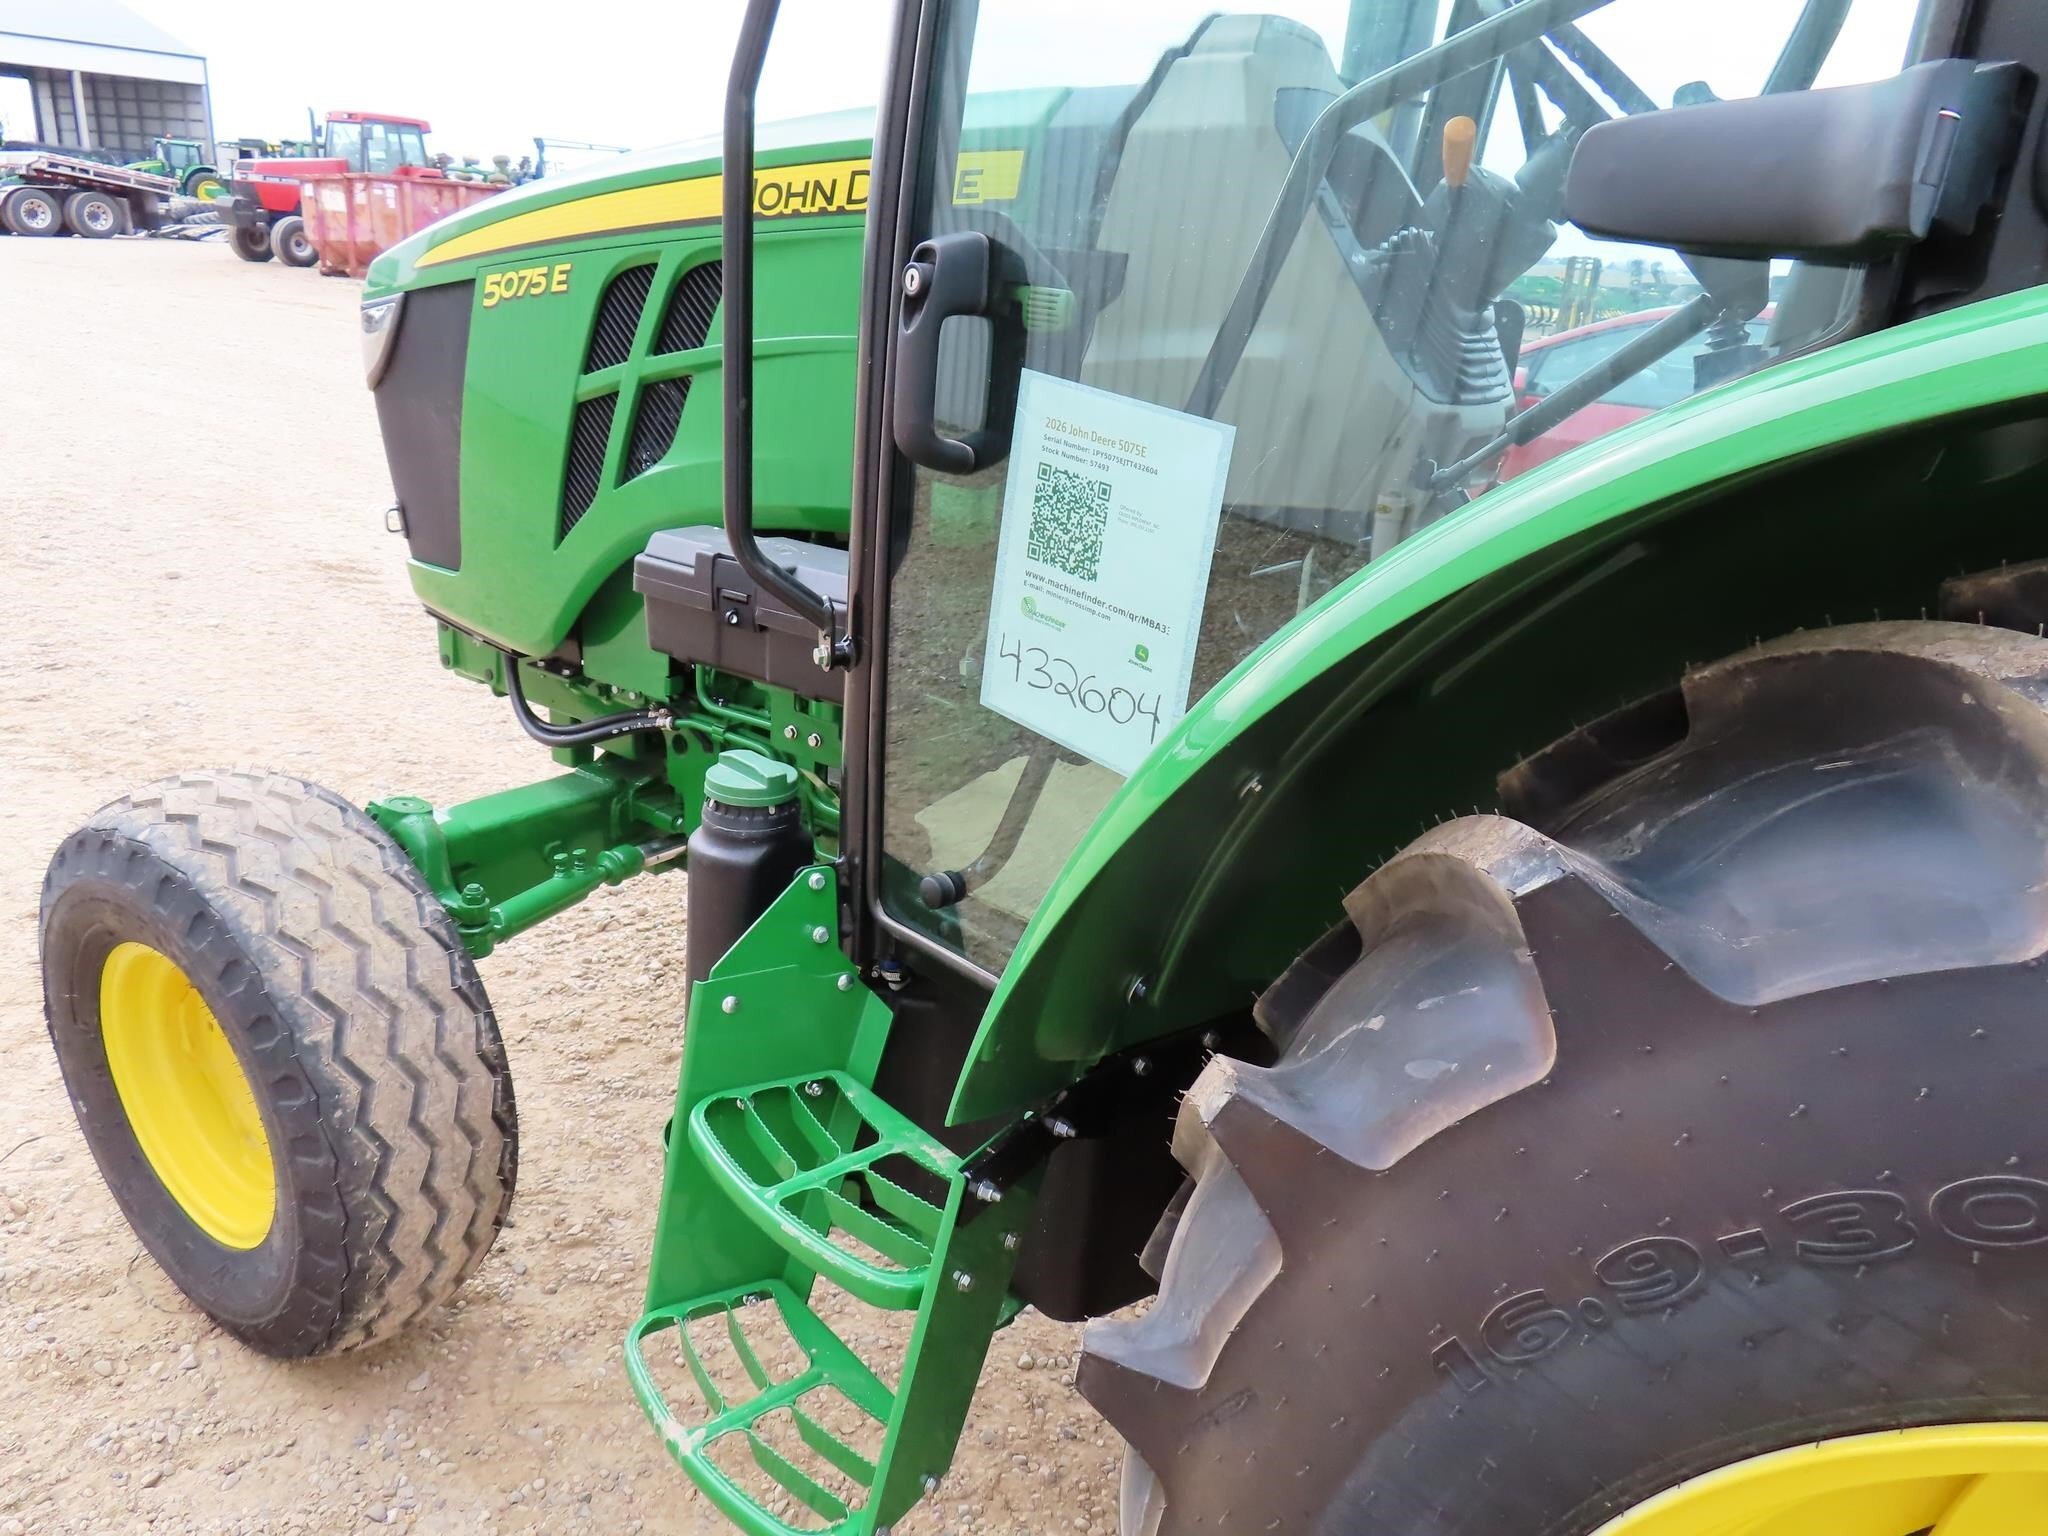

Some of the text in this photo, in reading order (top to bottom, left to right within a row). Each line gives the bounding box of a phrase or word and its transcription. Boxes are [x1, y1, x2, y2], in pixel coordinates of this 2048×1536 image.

[1043, 433, 1062, 445] Serial
[1063, 439, 1091, 454] Number:
[1045, 416, 1148, 458] 2026 John Deere 5075E
[1041, 445, 1060, 456] Stock
[1061, 450, 1088, 464] Number:
[1023, 579, 1045, 593] E-mail:
[999, 632, 1161, 745] 432604
